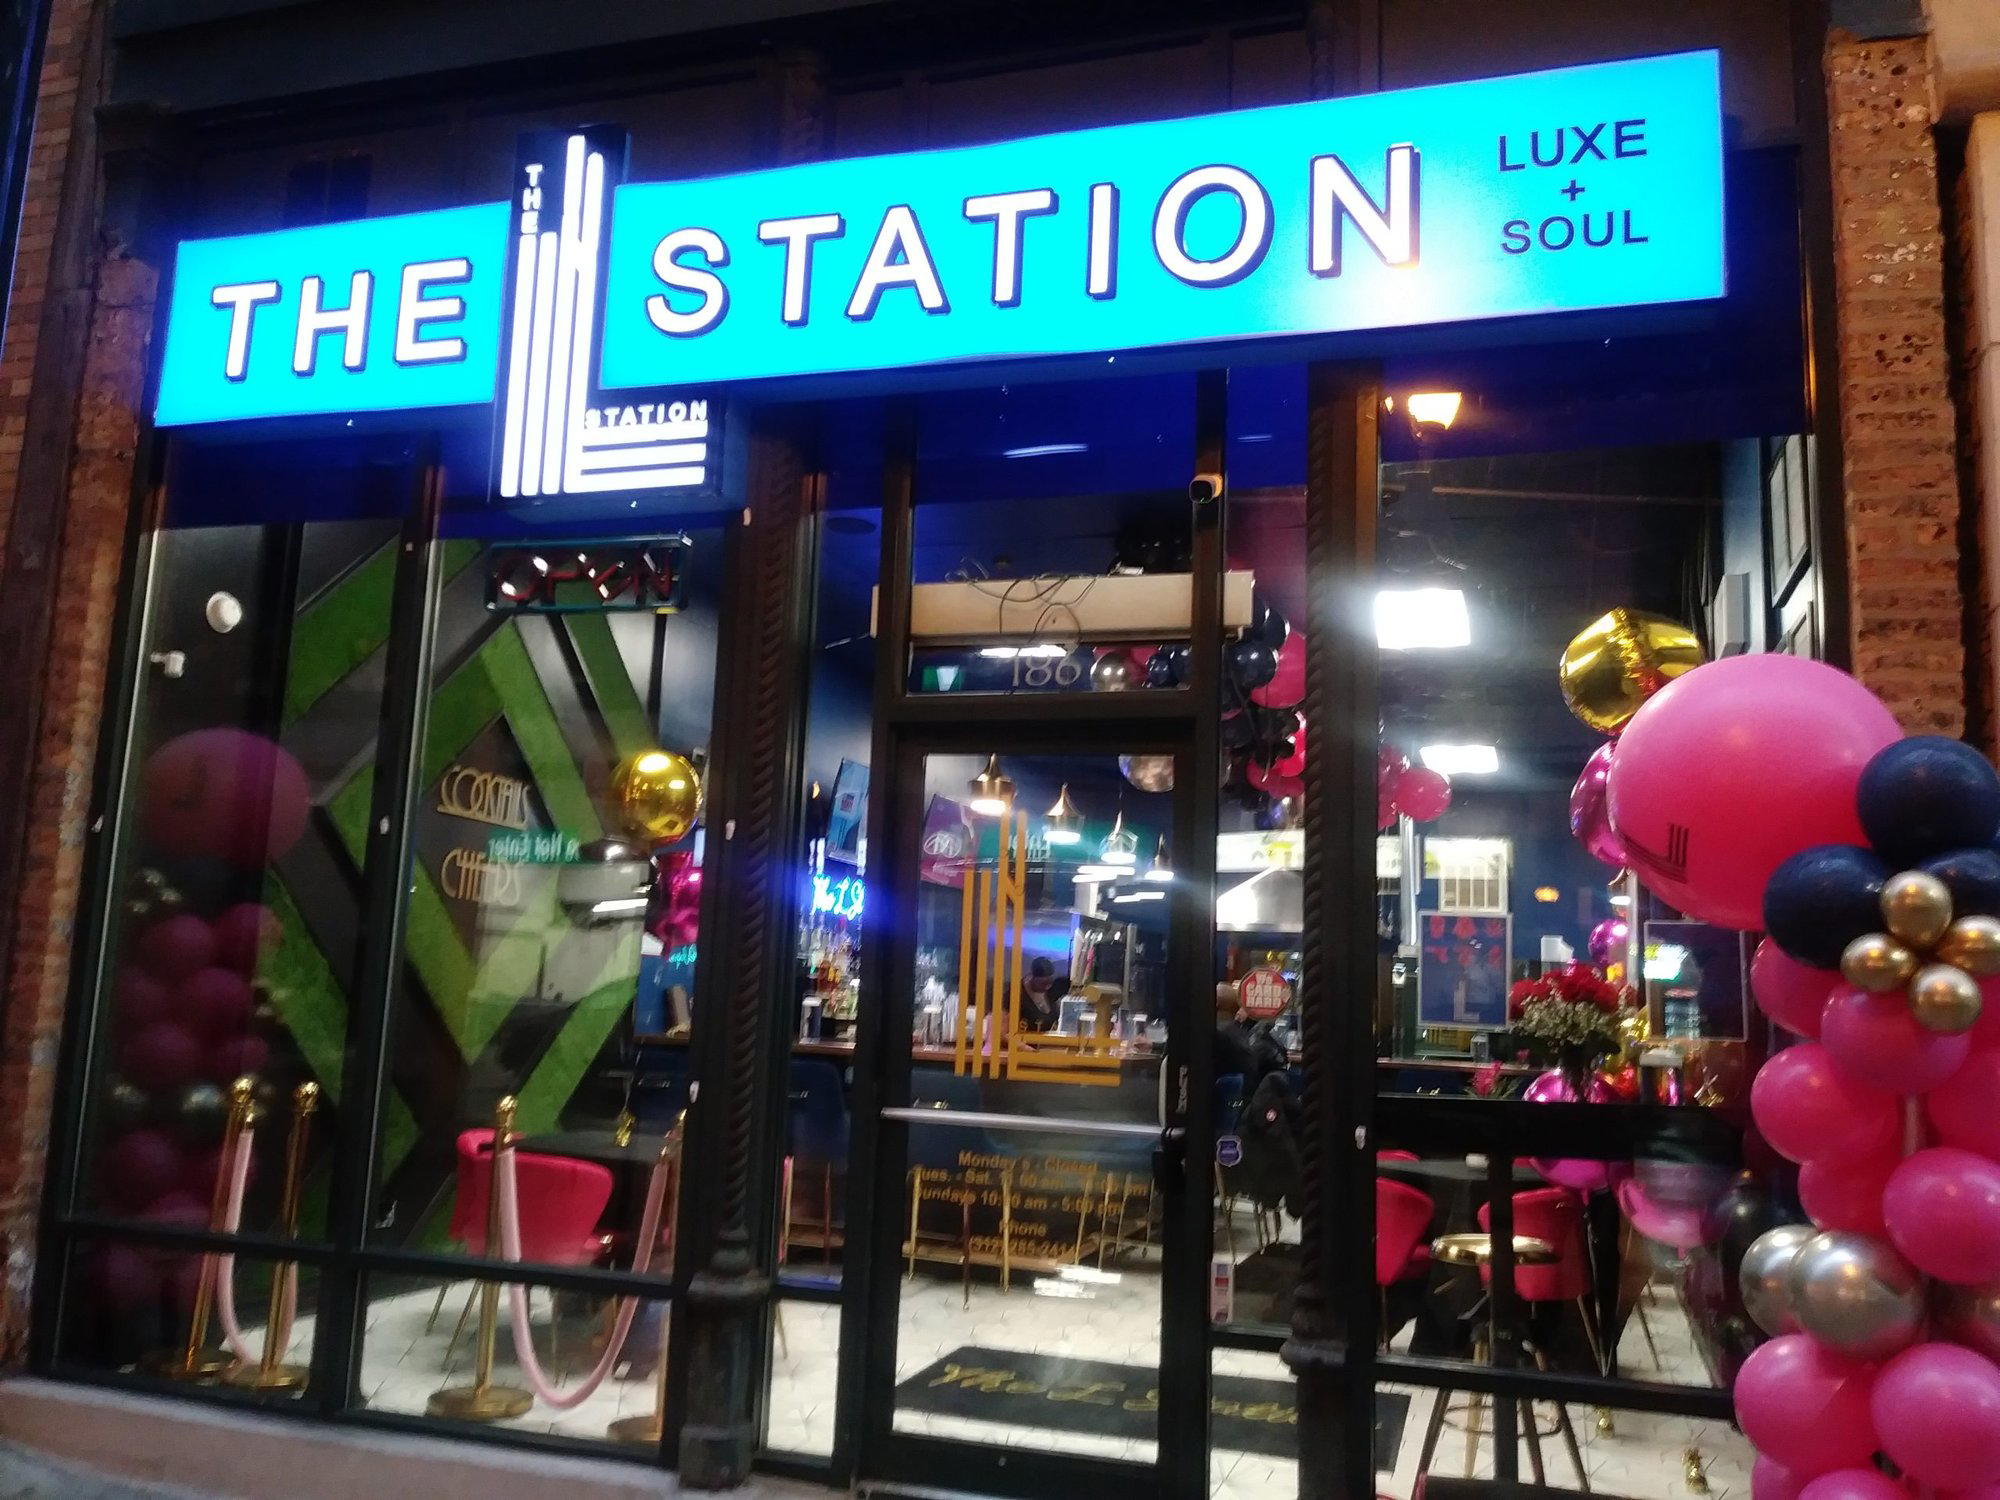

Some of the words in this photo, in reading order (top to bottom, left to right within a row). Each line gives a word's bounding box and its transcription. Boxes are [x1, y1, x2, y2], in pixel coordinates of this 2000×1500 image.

[1499, 118, 1648, 172] LUXE
[520, 163, 544, 234] THE
[1500, 210, 1650, 255] SOUL
[211, 256, 473, 384] THE
[645, 143, 1422, 340] STATION
[585, 399, 708, 430] STATION
[1010, 654, 1084, 688] 186
[981, 1190, 1022, 1209] 10:0
